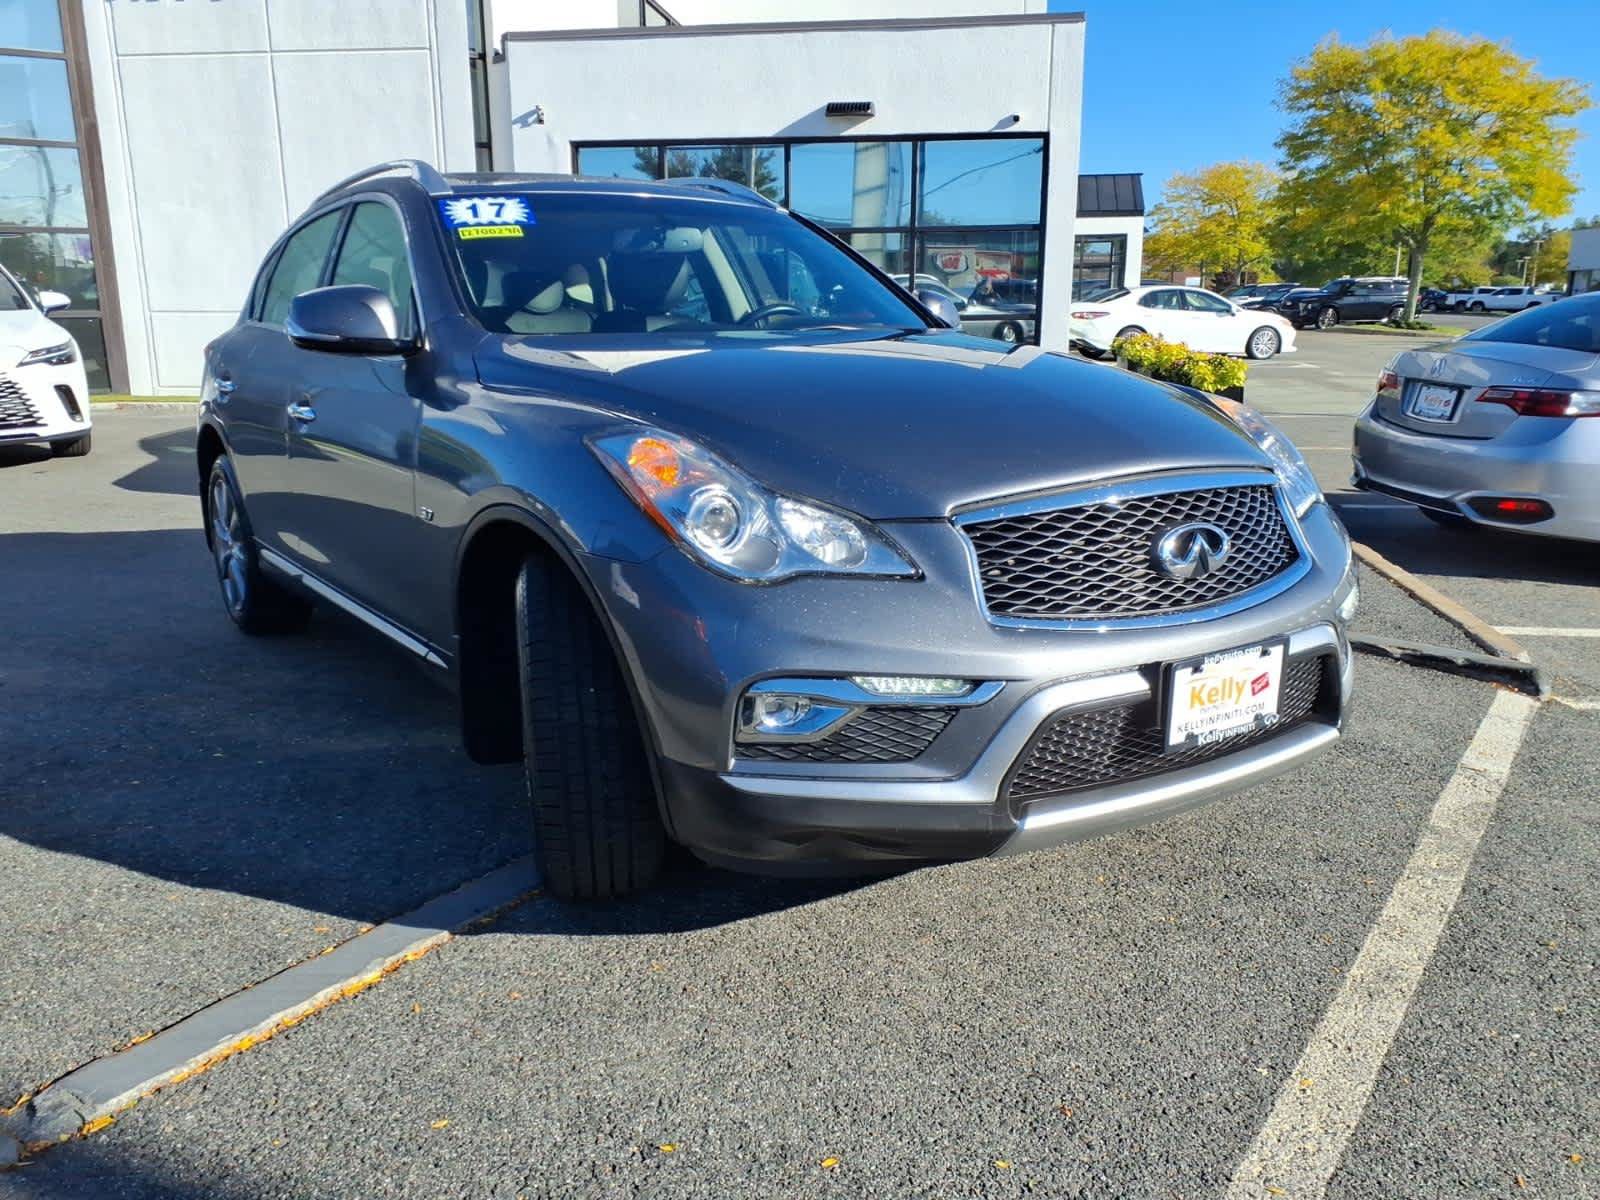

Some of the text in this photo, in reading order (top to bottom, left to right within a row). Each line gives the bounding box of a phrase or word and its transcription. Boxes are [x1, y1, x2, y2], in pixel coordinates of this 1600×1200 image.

[465, 202, 506, 219] 17
[1189, 676, 1247, 710] Kelly
[1177, 702, 1265, 734] KELLYINFINITI.COM
